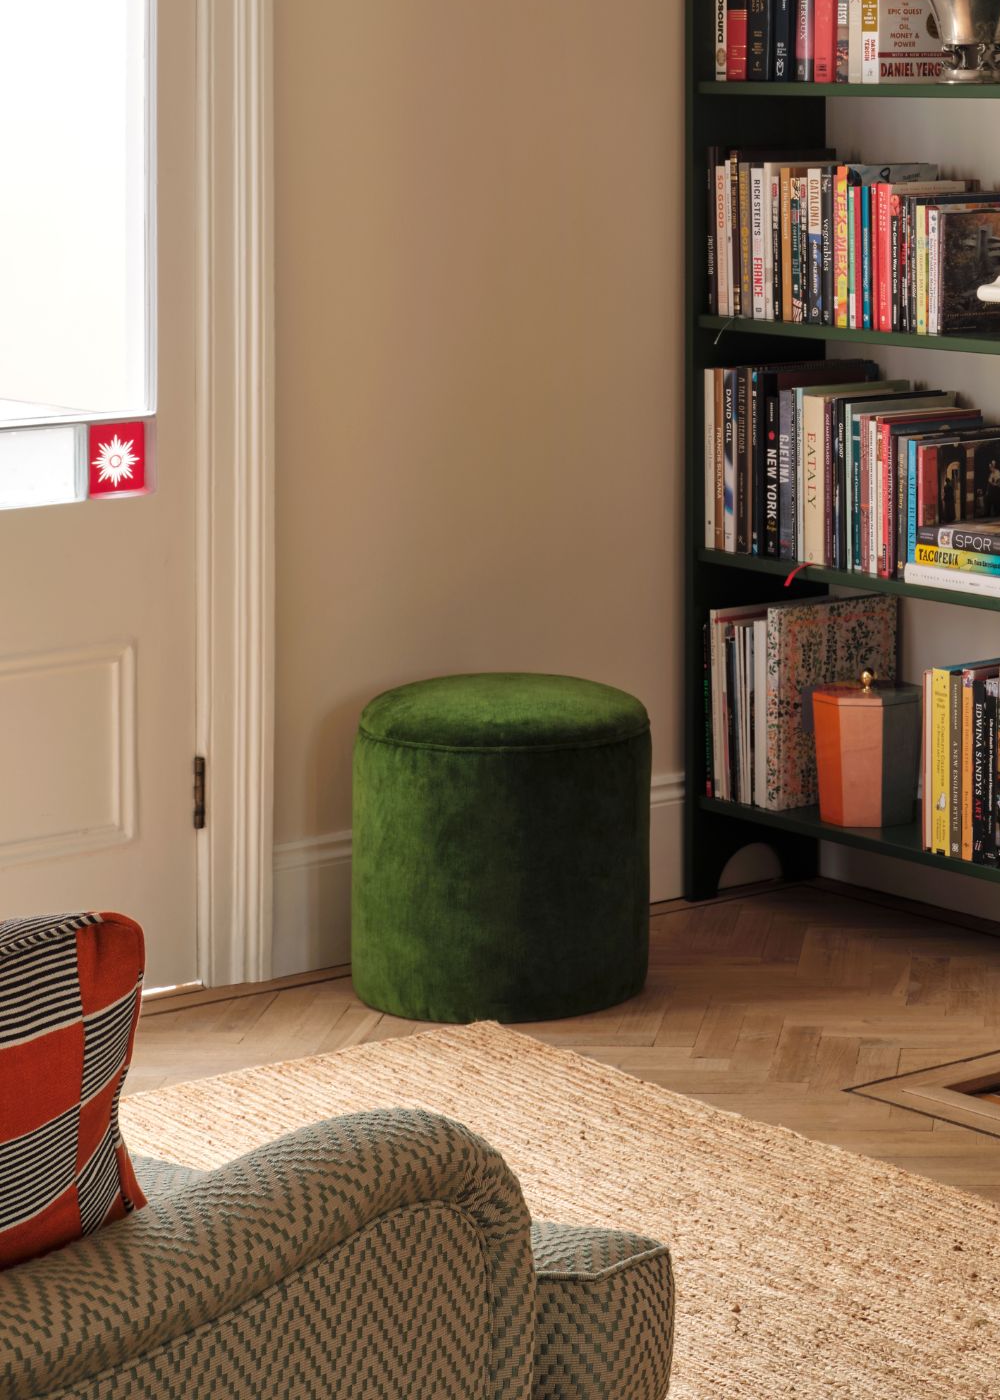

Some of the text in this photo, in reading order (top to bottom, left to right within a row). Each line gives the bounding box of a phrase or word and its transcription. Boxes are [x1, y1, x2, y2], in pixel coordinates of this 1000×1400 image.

[838, 3, 847, 24] FLESH
[880, 63, 942, 77] DANIEL YERG
[718, 175, 723, 190] SO
[810, 179, 819, 227] CATALONIA
[822, 219, 831, 271] vegetables
[838, 189, 847, 277] TEX-MEX
[753, 257, 763, 298] FRANCE
[738, 405, 745, 415] OF
[779, 435, 790, 483] GJELINA
[808, 433, 817, 510] EATALY
[767, 449, 777, 519] NEW YORK
[918, 548, 959, 566] TACOPEDIA
[955, 534, 992, 551] SPQR
